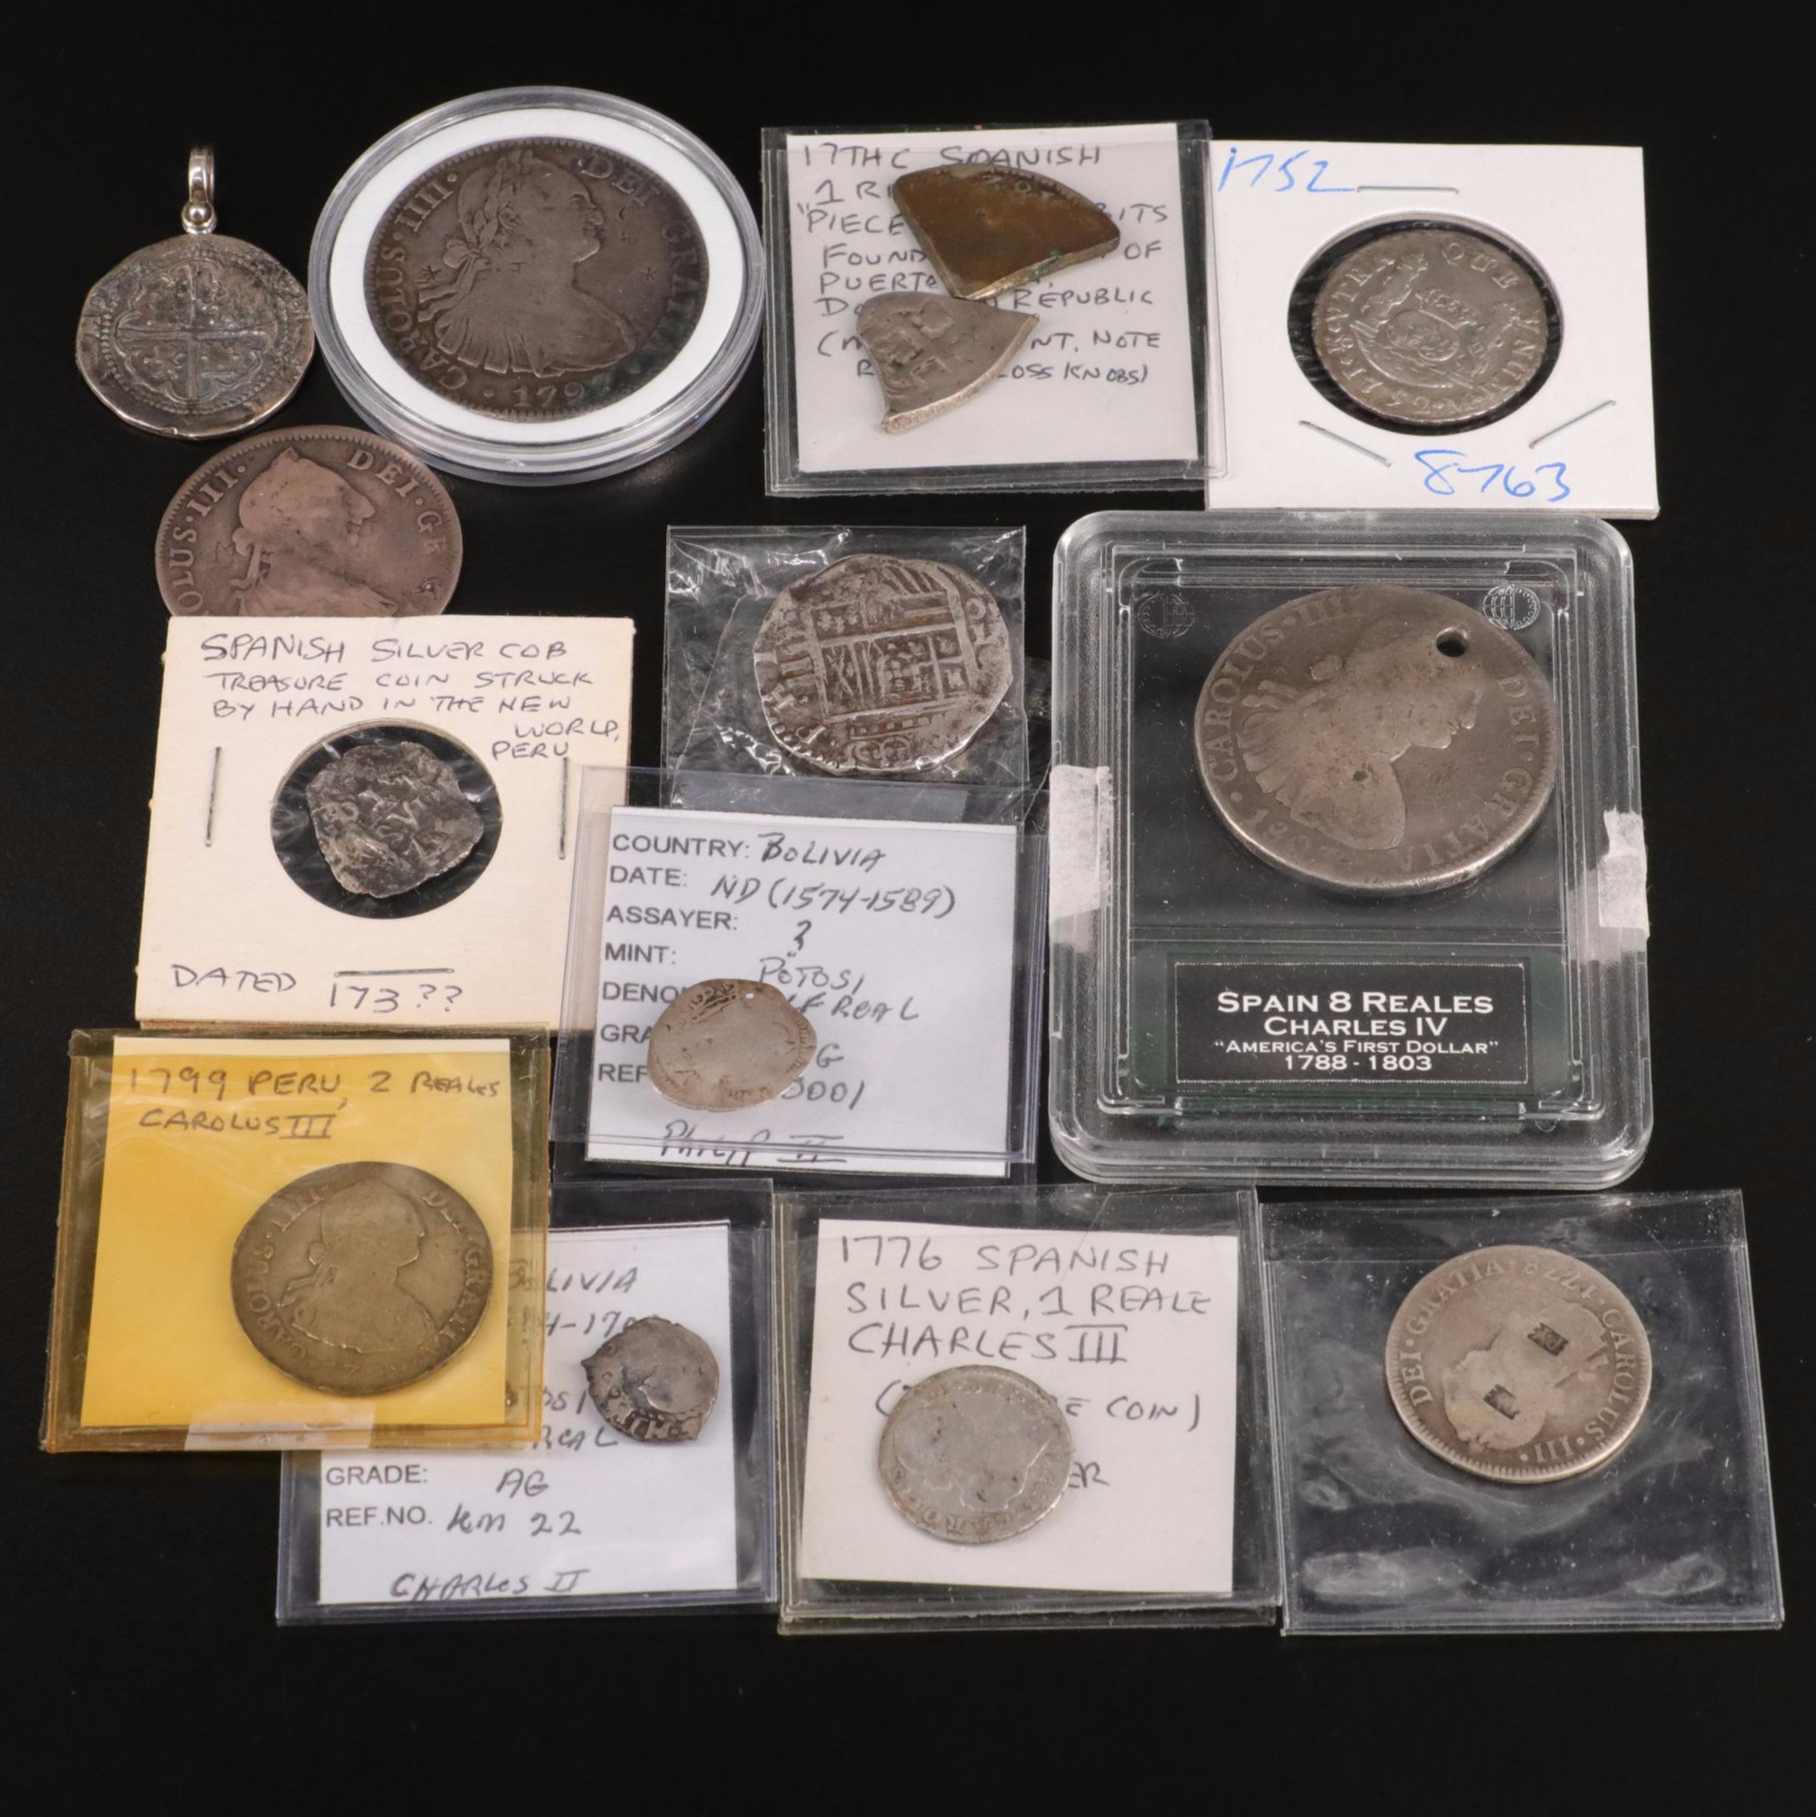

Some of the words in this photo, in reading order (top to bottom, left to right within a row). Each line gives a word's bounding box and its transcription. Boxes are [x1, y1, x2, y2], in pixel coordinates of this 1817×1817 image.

[940, 145, 1100, 167] SPANISH
[1218, 147, 1355, 192] 1752
[823, 244, 928, 268] FOUND
[1124, 240, 1162, 260] OF
[1013, 290, 1153, 310] REPUBLIC
[1093, 331, 1161, 348] NOTE
[348, 450, 418, 498] DEI
[201, 633, 344, 663] SPANISH
[372, 638, 483, 662] SILVER
[499, 641, 567, 661] COB
[205, 671, 348, 693] TREASURE
[376, 672, 450, 688] COIN
[473, 670, 593, 688] STRUCK
[212, 699, 253, 721] BY
[270, 697, 363, 717] HAND
[382, 697, 416, 710] IN
[431, 697, 486, 713] THE
[499, 696, 571, 713] NEW
[491, 739, 569, 760] PERU
[612, 833, 750, 859] COUNTRY:
[609, 865, 688, 887] DATE:
[711, 875, 761, 905] ND
[767, 877, 956, 919] (1574-1589)
[606, 905, 738, 931] ASSAYER:
[604, 942, 677, 965] MINT:
[171, 964, 298, 993] DATED
[1217, 991, 1318, 1013] SPAIN
[1329, 992, 1352, 1013] 8
[1362, 992, 1494, 1014] REALES
[1263, 1016, 1407, 1036] CHARLES
[1416, 1017, 1448, 1036] IV
[1343, 1040, 1400, 1053] FIRST
[1285, 1055, 1347, 1070] 1788
[1369, 1056, 1432, 1070] 1803
[130, 1066, 227, 1095] 1799
[248, 1067, 349, 1108] PERU,
[370, 1071, 392, 1094] 2
[139, 1108, 281, 1136] CAROLUS
[842, 1235, 942, 1271] 1776
[977, 1244, 1168, 1276] SPANISH
[847, 1281, 1029, 1321] SILVER,
[1039, 1286, 1074, 1317] 1
[1091, 1283, 1212, 1315] REALE
[1406, 1259, 1504, 1336] GRATIA
[848, 1322, 1058, 1360] CHARLES
[1065, 1324, 1128, 1363] III
[1401, 1351, 1433, 1407] DEI
[1584, 1309, 1637, 1444] CAROLUS
[1533, 1436, 1574, 1463] III
[326, 1465, 428, 1486] GRADE:
[496, 1468, 549, 1498] AG
[326, 1506, 433, 1528] REF.NO.
[530, 1511, 581, 1537] 22
[544, 1568, 591, 1594] II
